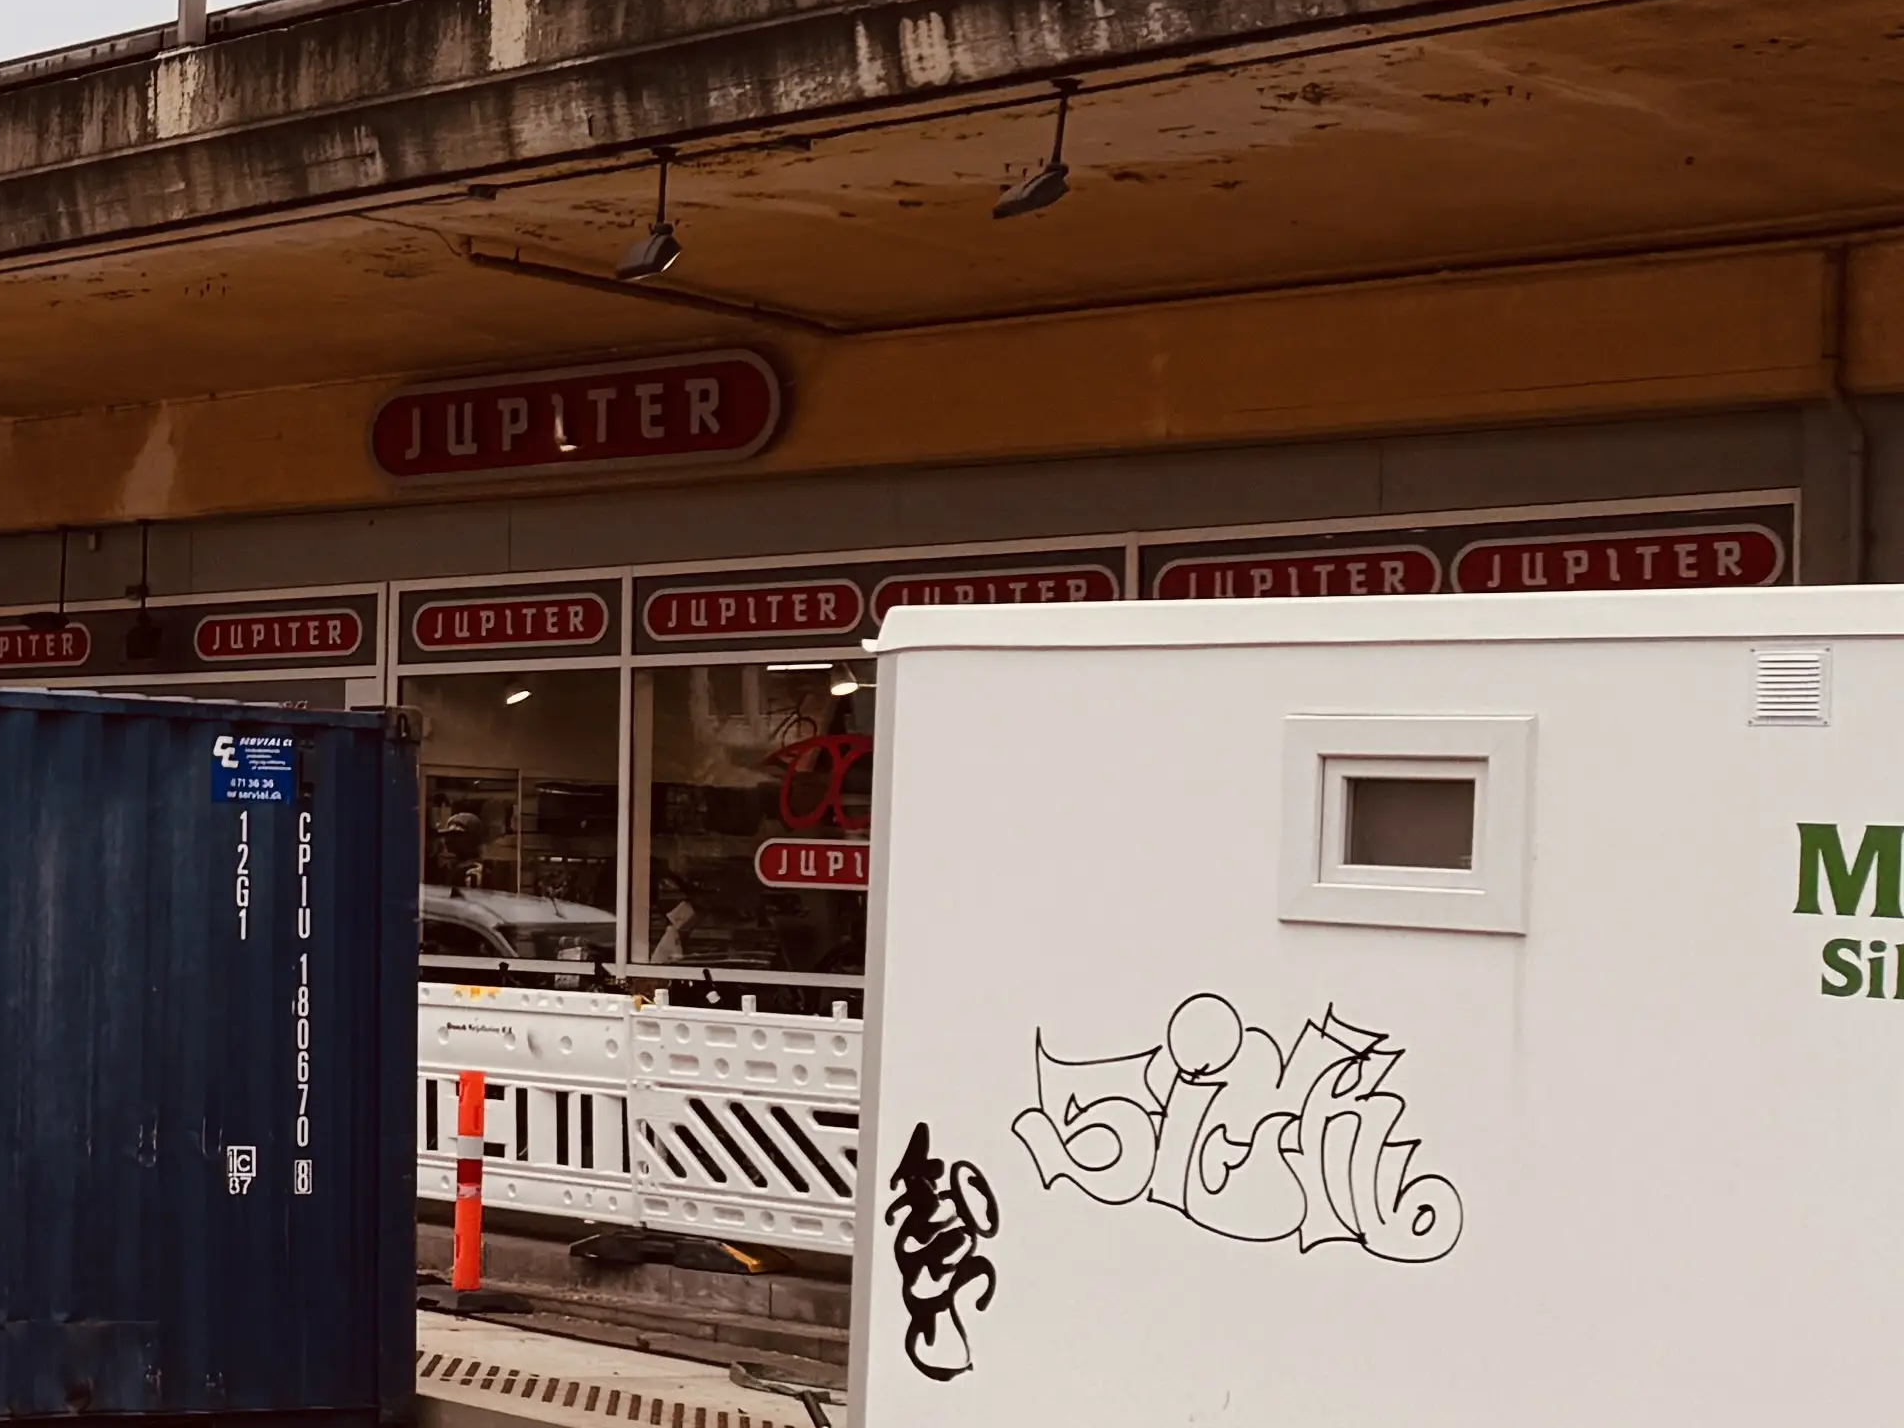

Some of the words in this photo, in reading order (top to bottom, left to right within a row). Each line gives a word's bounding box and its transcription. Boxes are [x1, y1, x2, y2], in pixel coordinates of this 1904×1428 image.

[404, 377, 722, 460] JUPITER
[1187, 561, 1406, 599] JUPITER
[1487, 540, 1745, 588] JUPITER
[433, 605, 586, 639] JUPITER
[667, 592, 839, 629] JUPITER
[211, 619, 343, 651] JUPITER
[235, 810, 251, 941] 12G1
[297, 812, 312, 940] CPIU
[778, 849, 864, 878] JUPI
[296, 953, 310, 1148] 180670
[229, 1177, 252, 1195] 87
